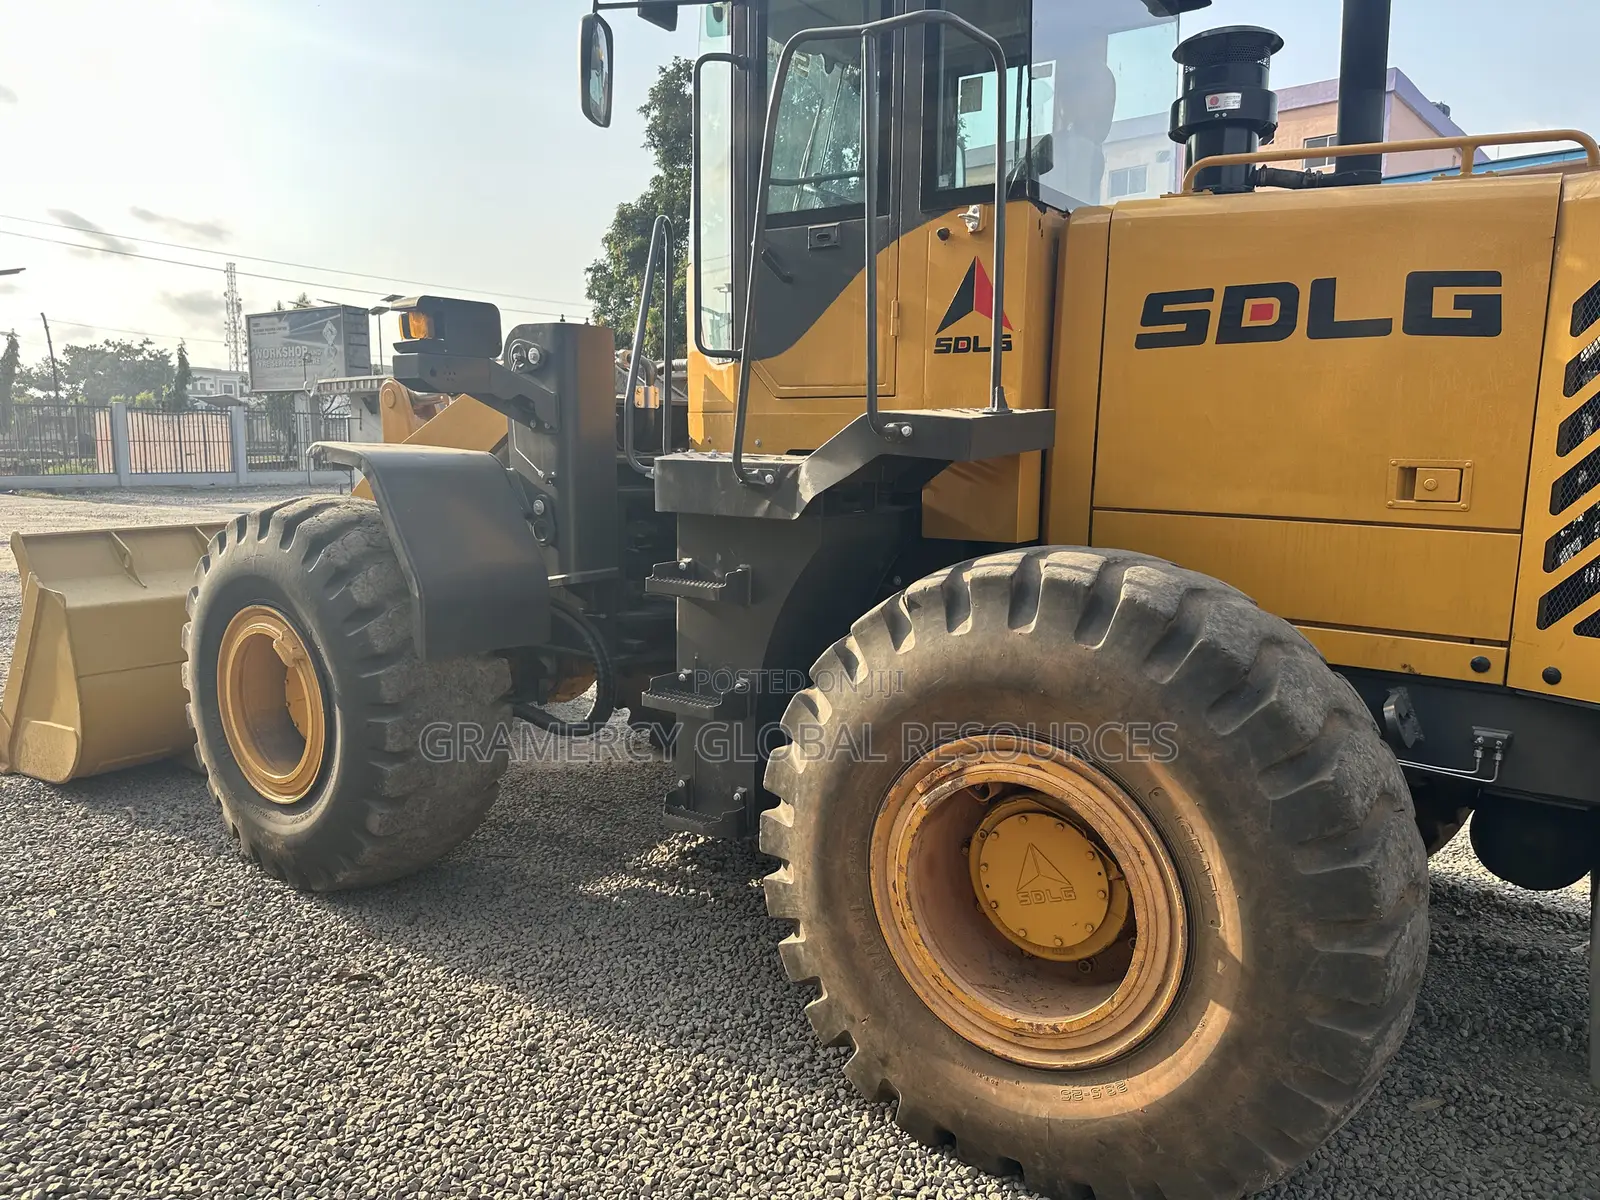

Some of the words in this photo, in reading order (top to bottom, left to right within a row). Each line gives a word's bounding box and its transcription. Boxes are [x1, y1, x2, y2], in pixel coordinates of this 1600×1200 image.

[1134, 270, 1502, 350] SDLG
[254, 346, 308, 359] WORKSHOP
[1016, 886, 1077, 906] SDLG
